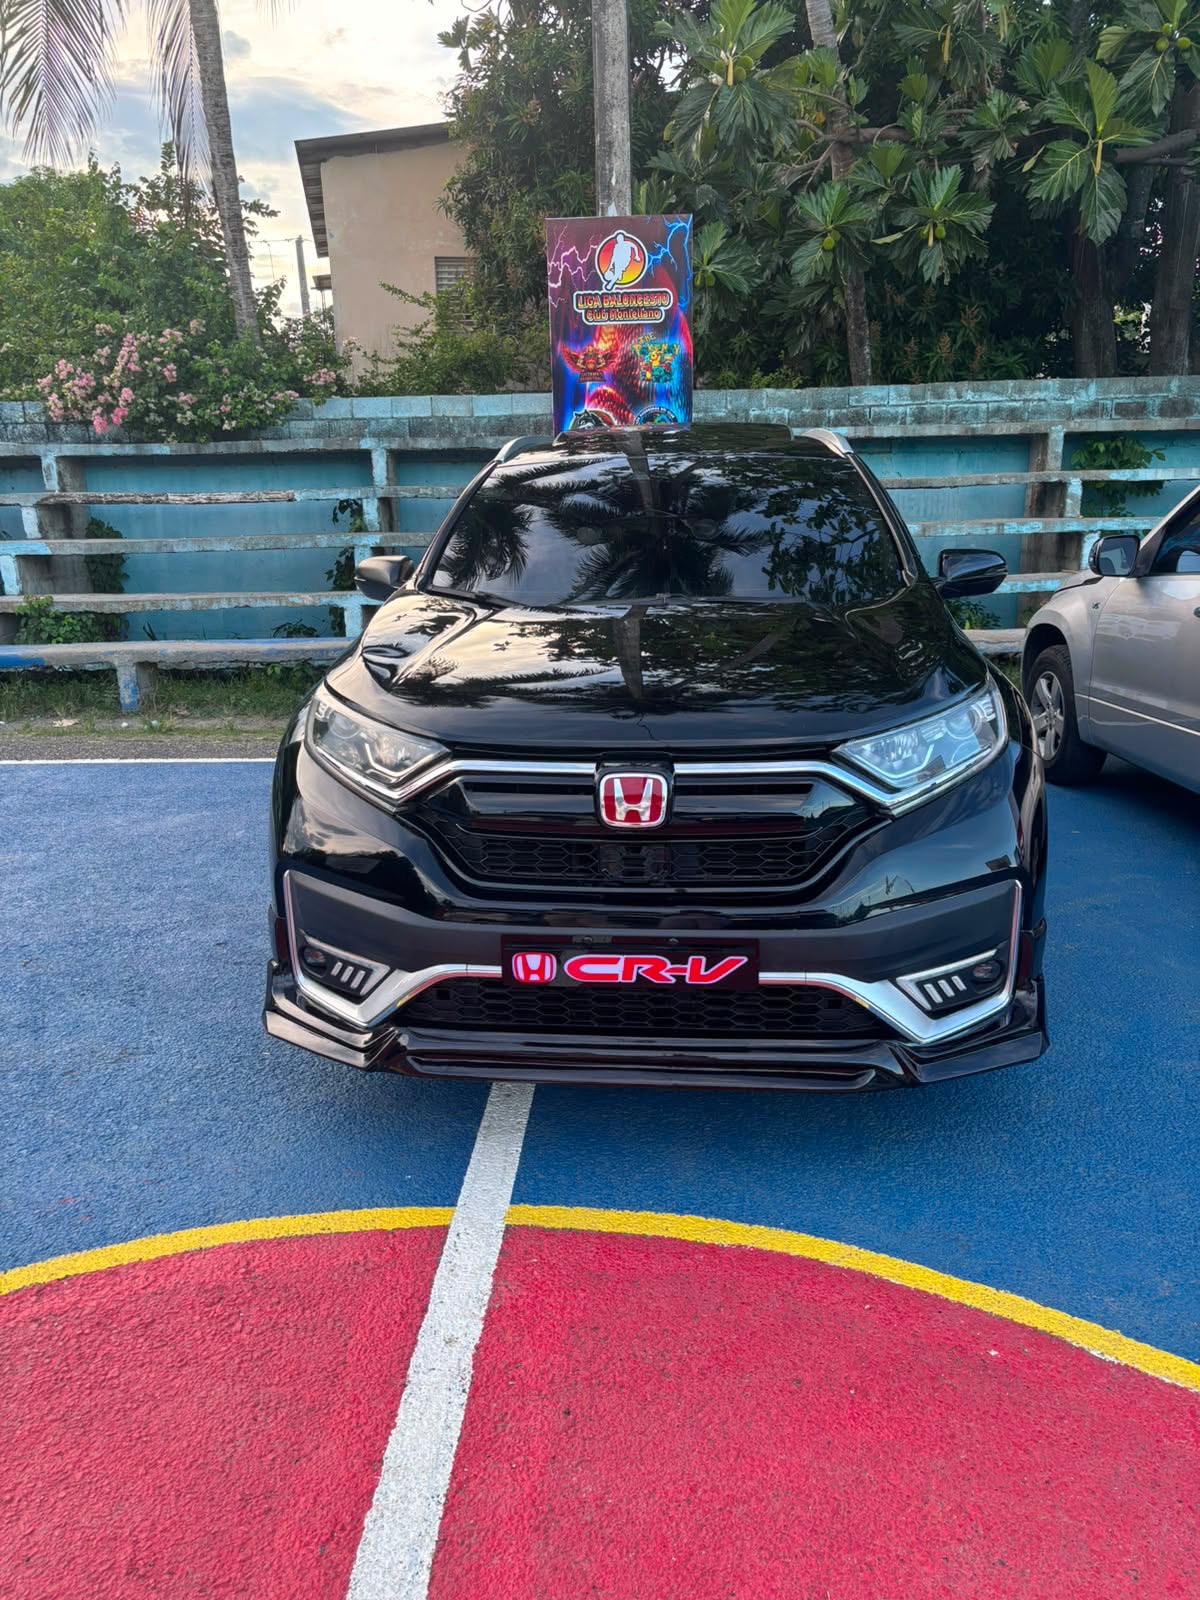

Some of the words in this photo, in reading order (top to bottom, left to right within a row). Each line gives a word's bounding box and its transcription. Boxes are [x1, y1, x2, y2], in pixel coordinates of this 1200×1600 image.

[577, 294, 600, 308] LIGA
[602, 292, 668, 307] BALONCESTO
[586, 309, 608, 321] Club
[564, 954, 748, 984] CR-V
